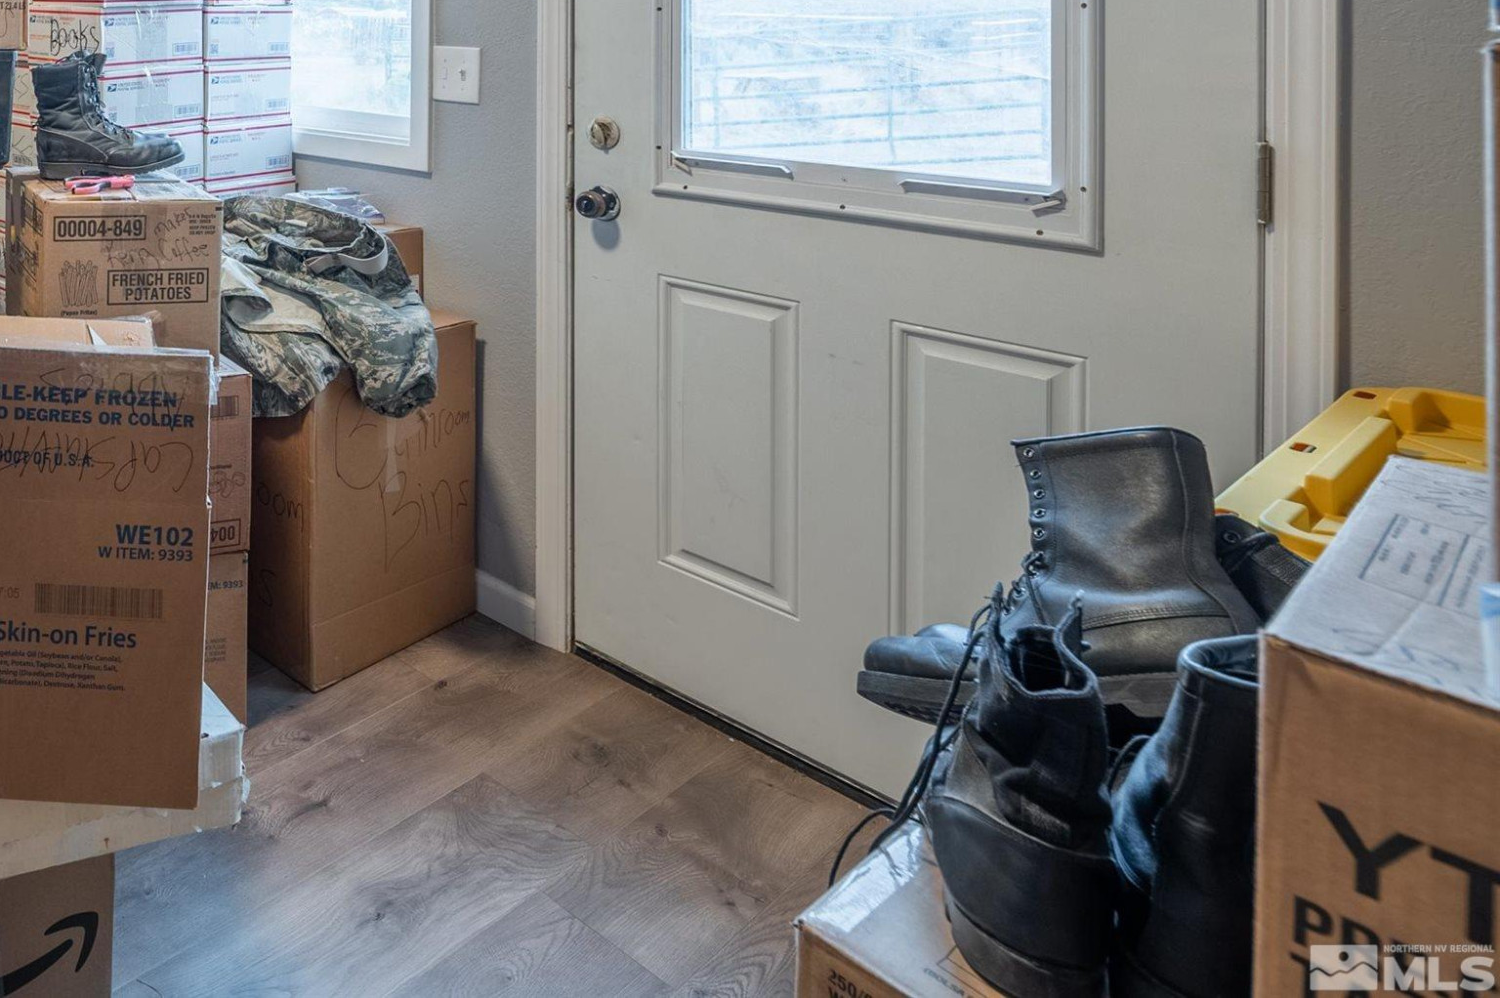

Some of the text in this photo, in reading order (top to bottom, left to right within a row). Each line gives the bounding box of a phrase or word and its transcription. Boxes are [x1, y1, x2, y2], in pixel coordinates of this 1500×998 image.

[57, 218, 143, 238] 00004-849
[112, 272, 205, 287] FRENCH FRIED
[125, 287, 191, 301] POTATOES
[95, 390, 177, 407] FROZEN
[14, 407, 92, 424] DEGREES
[100, 411, 122, 425] OR
[128, 413, 194, 428] COLDER
[33, 452, 50, 464] OF
[115, 524, 193, 547] WE102
[211, 525, 235, 542] 004
[98, 546, 193, 561] W ITEM: 9393
[85, 625, 137, 650] Fries
